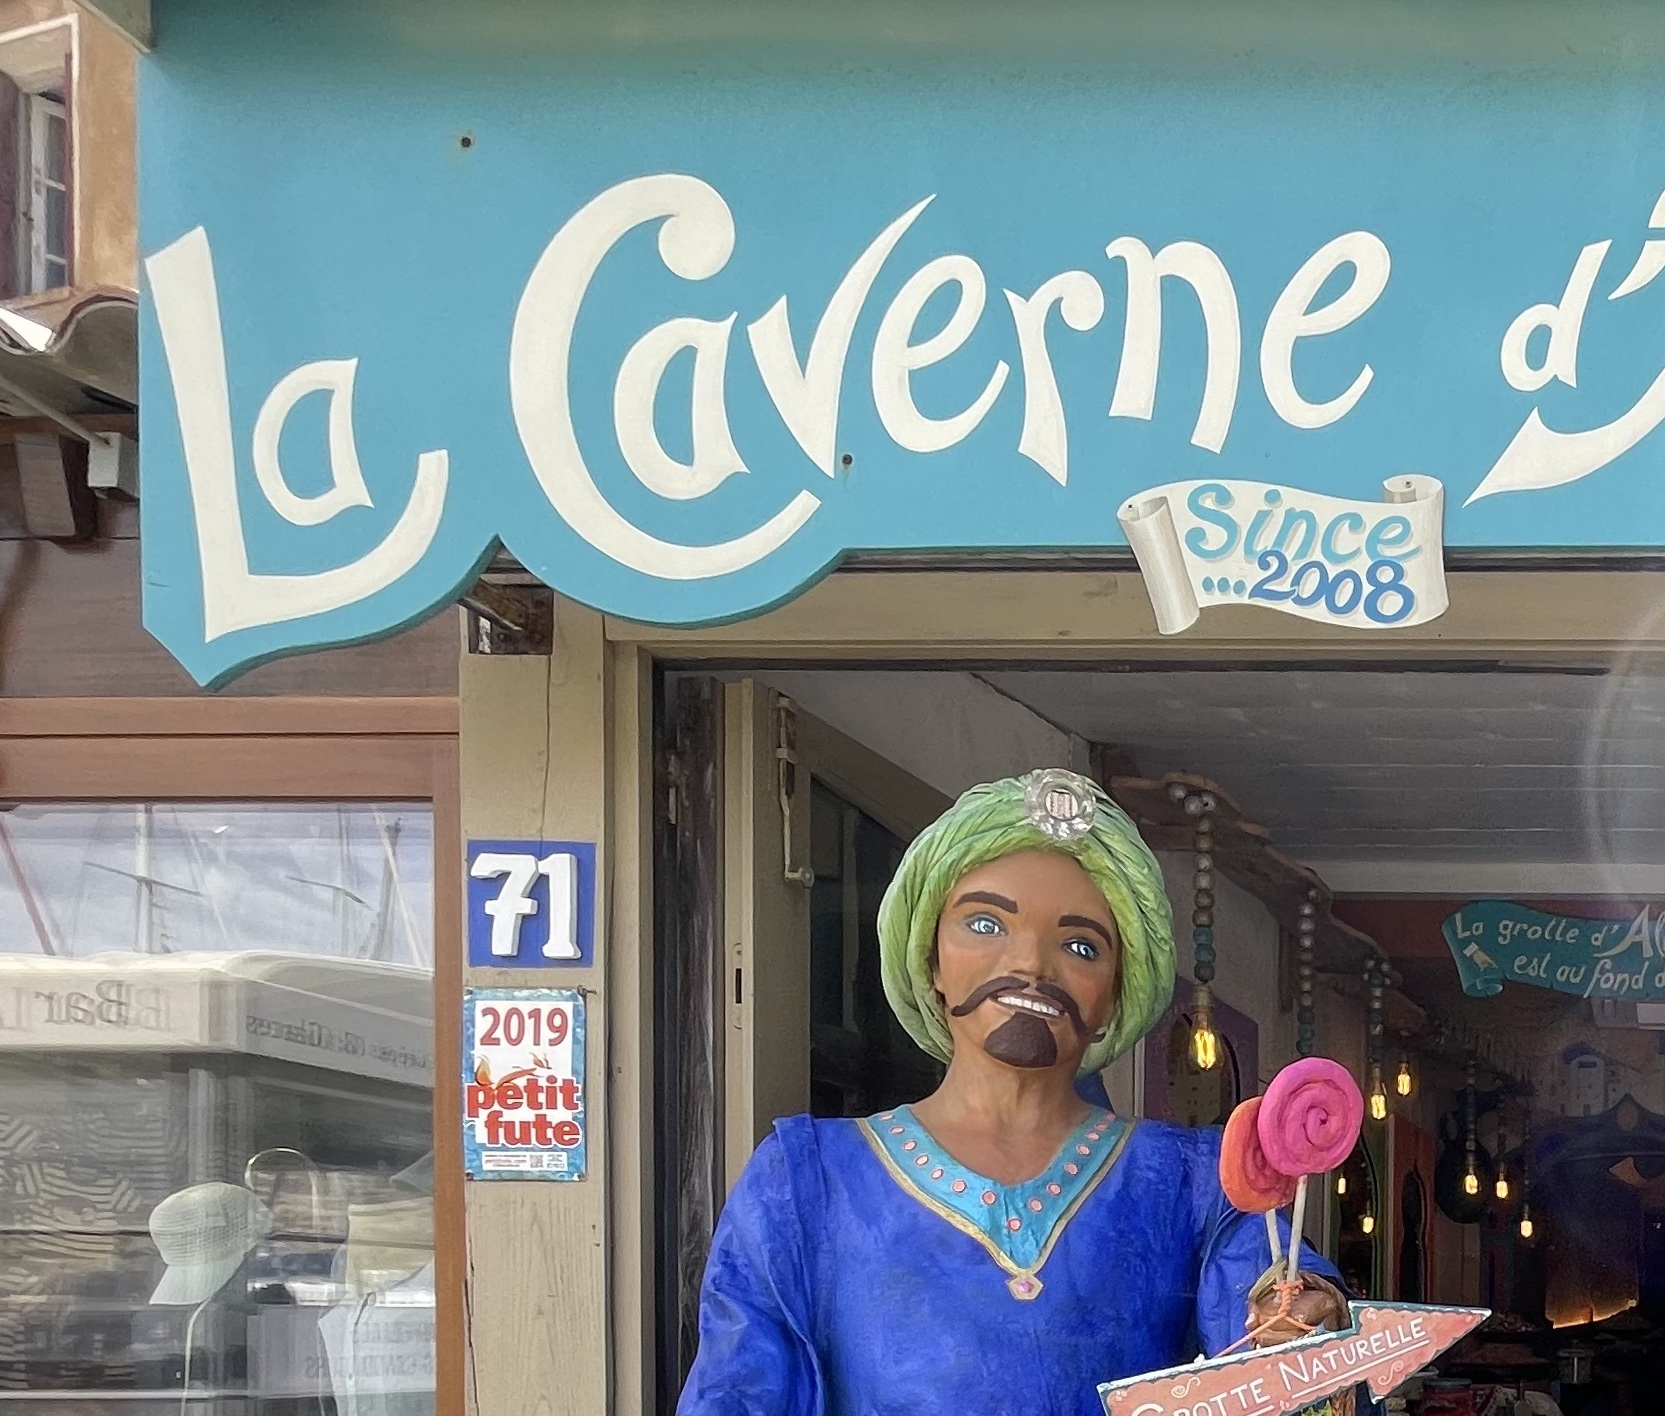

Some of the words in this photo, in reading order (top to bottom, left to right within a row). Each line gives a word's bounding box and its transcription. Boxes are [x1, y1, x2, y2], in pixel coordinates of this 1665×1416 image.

[145, 225, 449, 643] La
[510, 173, 1392, 580] Caverne
[1185, 483, 1422, 563] Since
[470, 852, 582, 960] 71
[1455, 912, 1484, 939] La
[1497, 918, 1580, 945] grotte
[1514, 952, 1551, 978] est
[1556, 965, 1587, 984] au
[1583, 959, 1650, 998] fond
[480, 1007, 569, 1046] 2019
[467, 1074, 579, 1118] petit
[1278, 1317, 1427, 1391] NATURELLE
